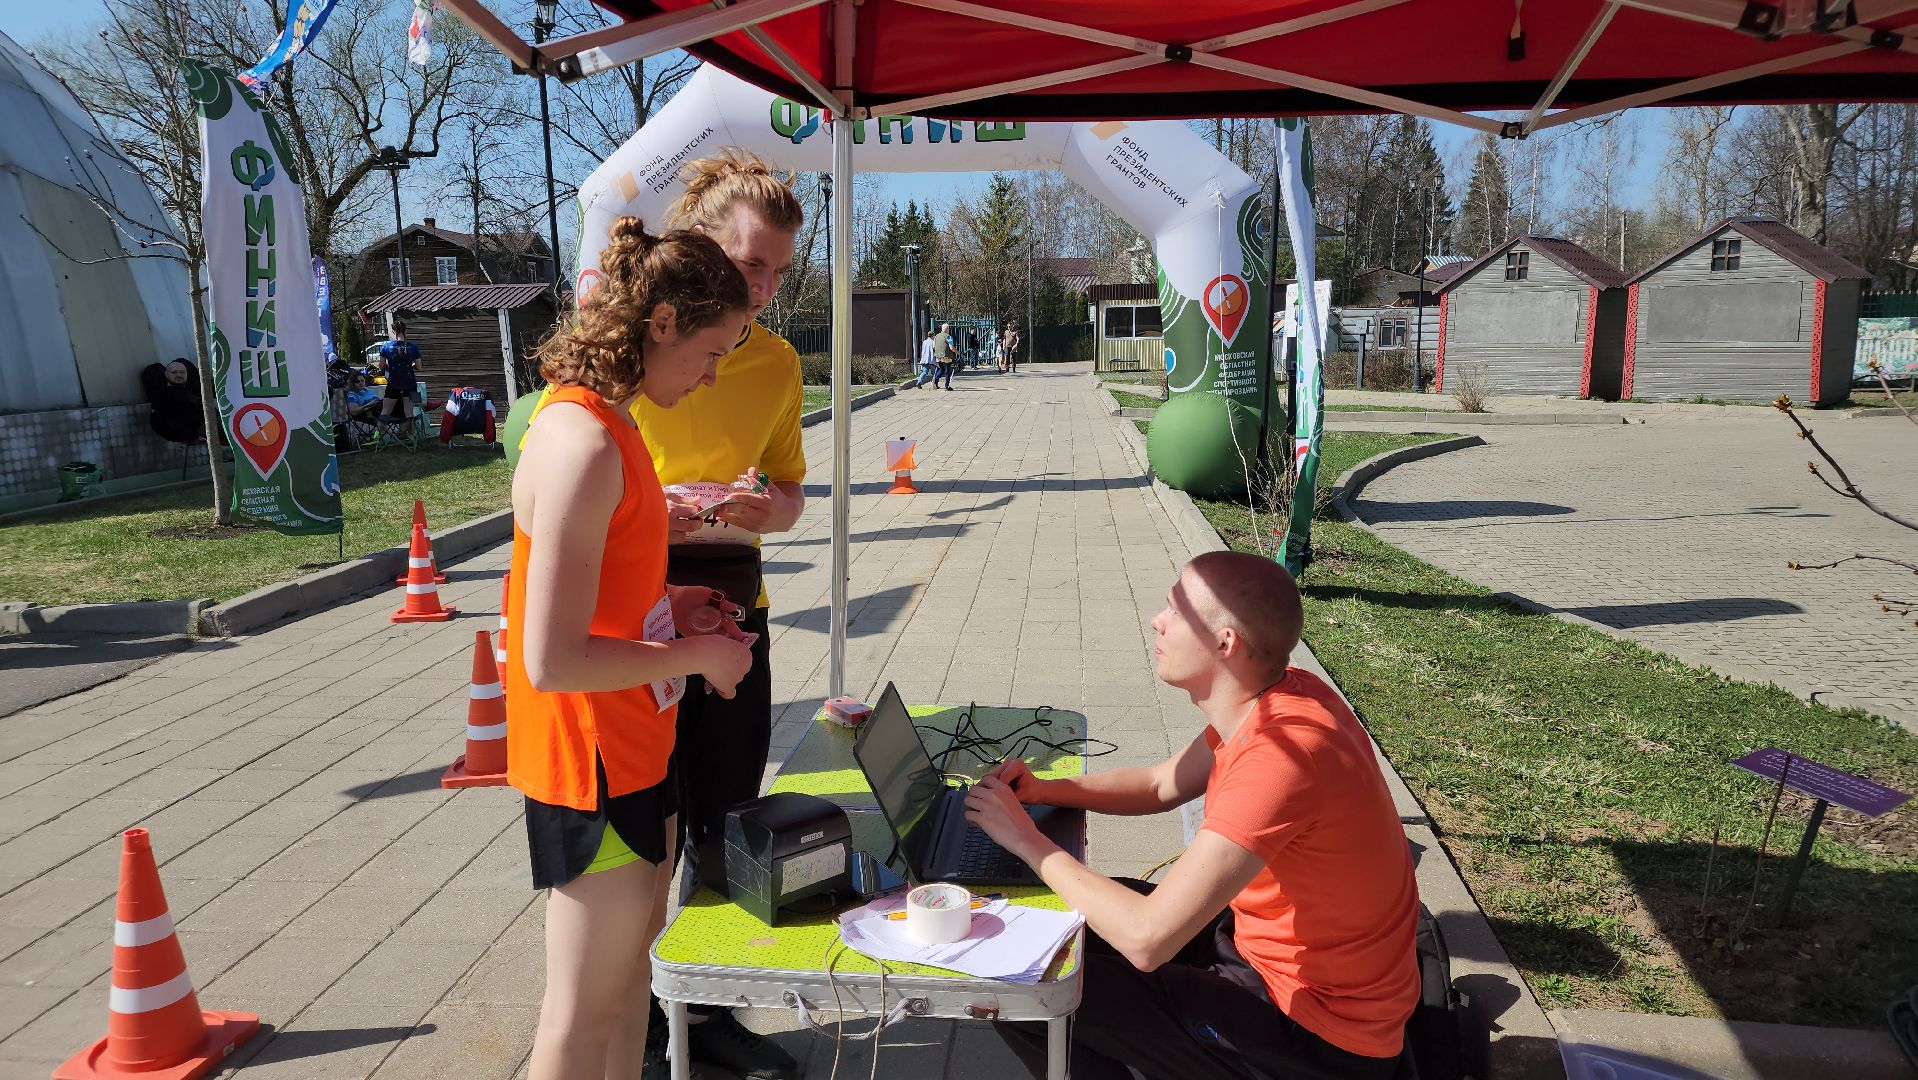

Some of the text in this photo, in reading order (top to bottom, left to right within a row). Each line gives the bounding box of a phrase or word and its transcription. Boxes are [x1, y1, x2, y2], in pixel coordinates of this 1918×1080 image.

[646, 126, 714, 186] ПРЕЗИДЕНТСКИХ
[1122, 136, 1149, 162] ФОНД
[640, 154, 665, 177] ФОНД
[1106, 154, 1147, 189] ГРАНТОВ
[1113, 145, 1188, 208] ПРЕЗИДЕНТСКИХ
[230, 139, 291, 398] ФИНИШ
[1214, 351, 1255, 362] МОСКОВСКАЯ
[1219, 360, 1256, 370] ОБЛАСТНАЯ
